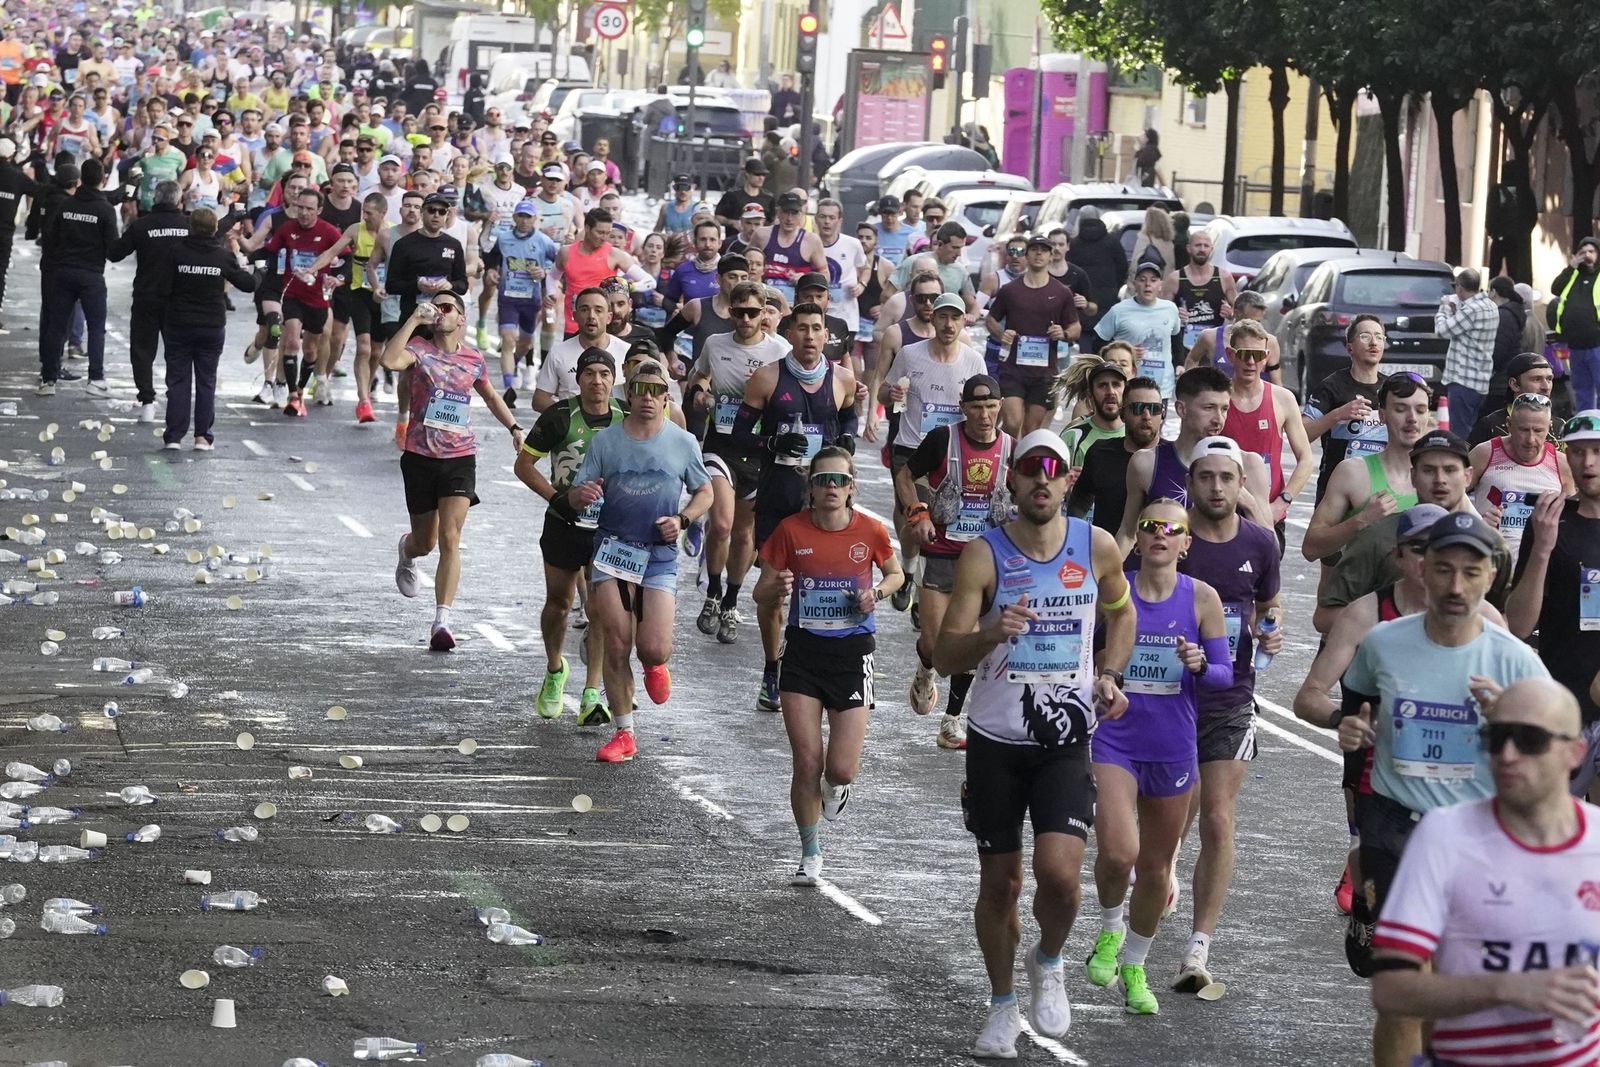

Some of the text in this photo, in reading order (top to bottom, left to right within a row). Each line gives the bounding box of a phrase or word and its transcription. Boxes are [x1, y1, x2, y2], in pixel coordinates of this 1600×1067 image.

[601, 16, 622, 28] 30
[62, 211, 98, 224] VOLUNTEER
[148, 228, 189, 238] VOLUNTEER
[178, 265, 221, 276] VOLUNTEER
[930, 384, 944, 392] FRA
[435, 410, 460, 424] SIMON
[956, 522, 986, 532] ABDOU
[795, 547, 814, 556] HOKA
[600, 551, 644, 574] THIBAULT
[818, 580, 852, 589] ZURICH
[819, 595, 837, 604] 6484
[1042, 593, 1094, 608] AZZURRI
[803, 606, 853, 618] VICTORIA
[1046, 610, 1073, 618] TEAM
[1034, 623, 1074, 633] ZURICH
[1139, 634, 1177, 645] ZURICH
[1034, 643, 1056, 652] 6346
[1139, 652, 1160, 663] 7342
[1008, 661, 1036, 670] MARCO
[1129, 665, 1168, 680] ROMY
[1421, 706, 1469, 721] ZURICH
[1421, 728, 1446, 741] 7111
[1422, 744, 1443, 760] JO
